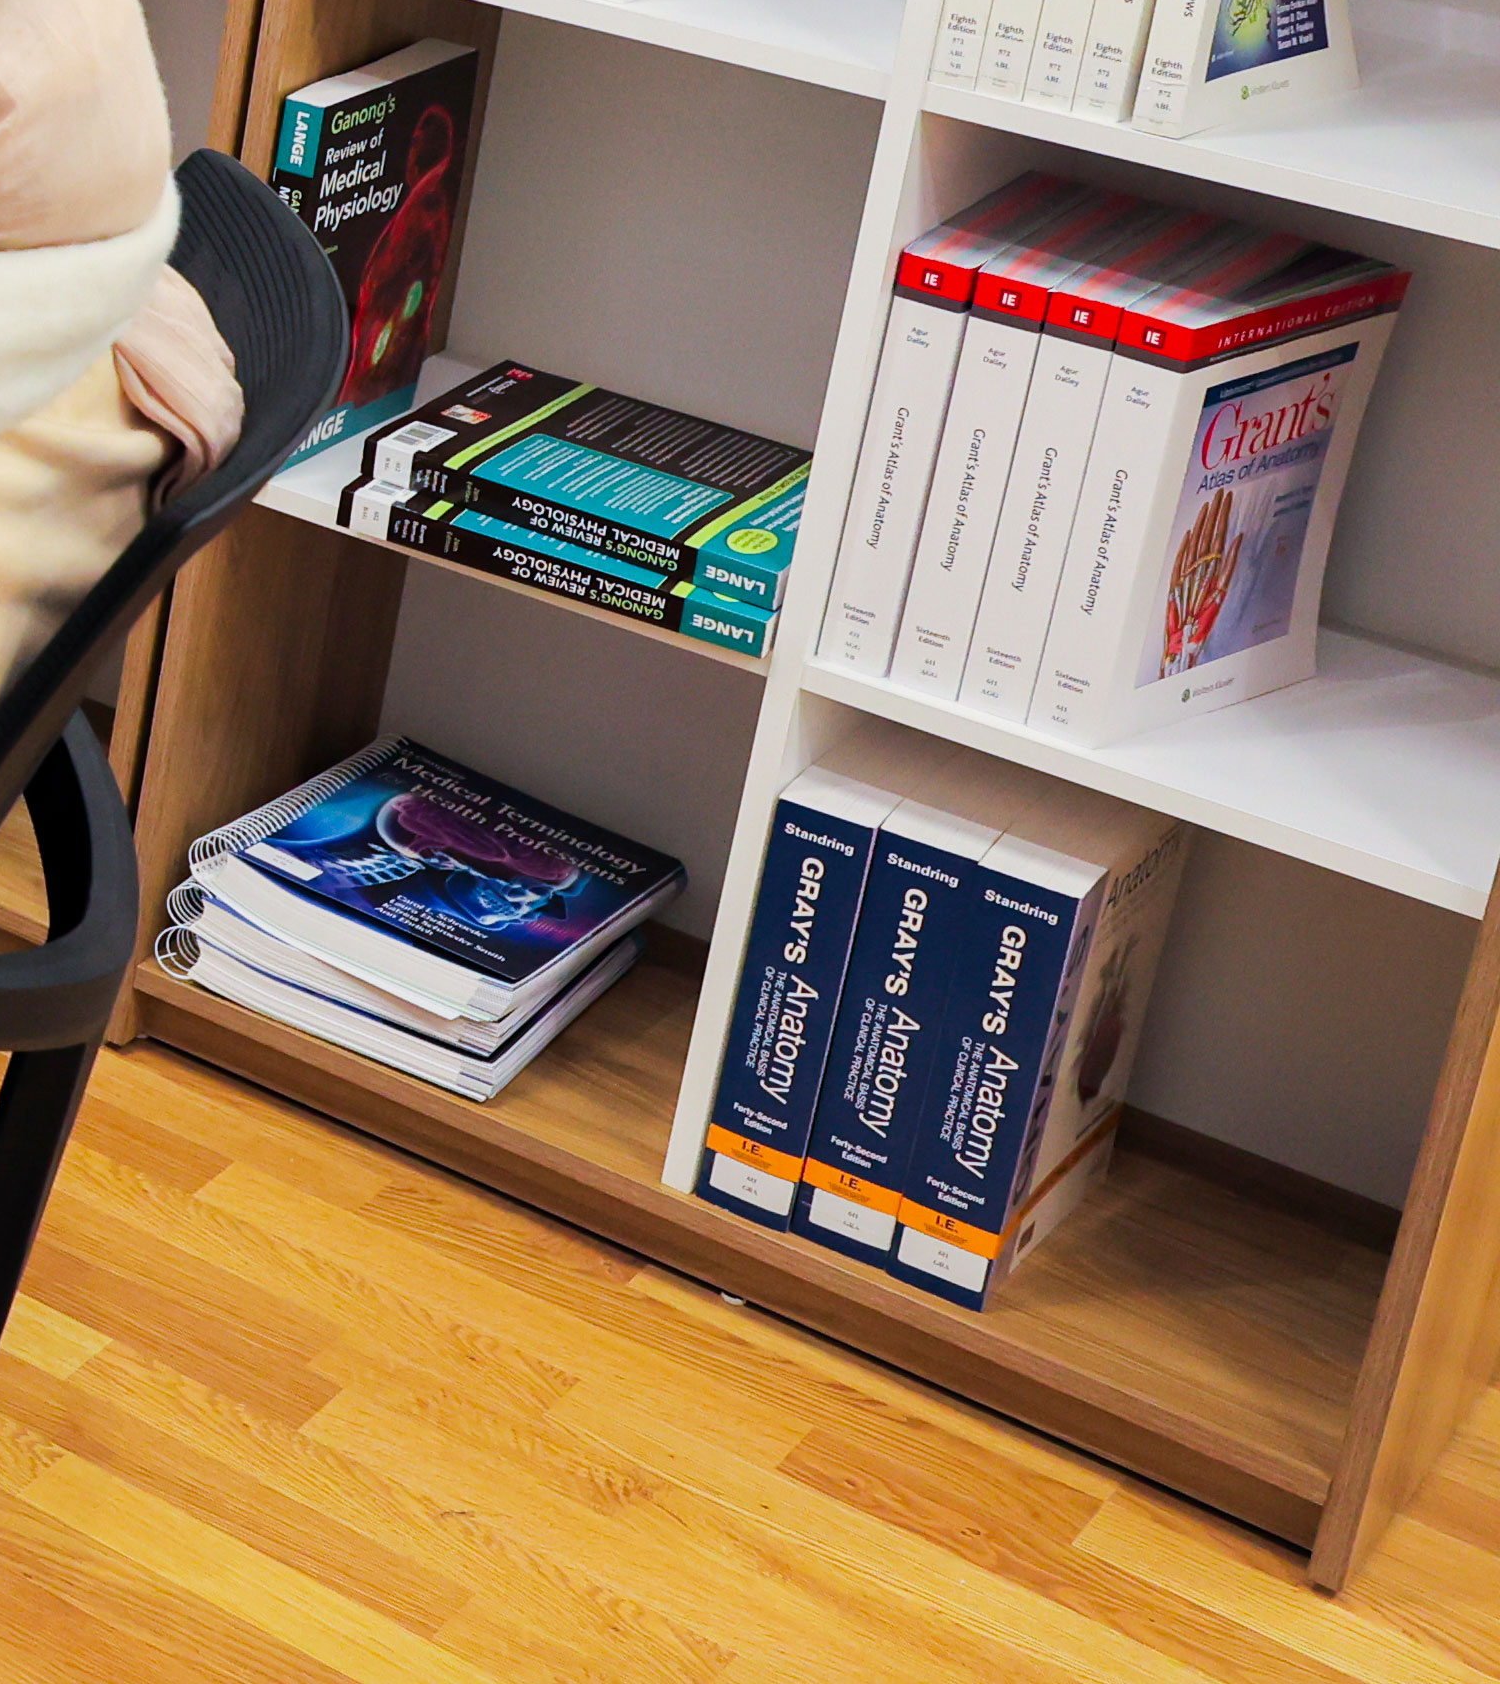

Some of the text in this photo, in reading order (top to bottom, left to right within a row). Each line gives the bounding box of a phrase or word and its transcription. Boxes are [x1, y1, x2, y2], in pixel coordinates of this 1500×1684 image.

[331, 93, 395, 134] Ganong's
[290, 111, 310, 168] LANGE
[325, 128, 384, 166] Review of
[320, 151, 386, 199] Medical
[314, 183, 403, 232] Physiology
[924, 272, 938, 286] IE
[1146, 330, 1160, 345] IE
[1218, 296, 1375, 348] INTERNATIONAL EDITION
[1202, 373, 1334, 470] Grant's
[866, 407, 909, 549] Grant's Atlas of Anatomy
[1197, 443, 1318, 494] Atlas of Anatomy
[511, 497, 680, 560] MEDICAL PHYSIOLOGY
[530, 517, 678, 571] GANONG'S REVIEW OF
[705, 565, 767, 595] LANGE
[392, 757, 647, 874] Medical Terminology
[409, 783, 627, 886] Health Professions
[784, 823, 855, 857] Standring
[984, 890, 1058, 926] Standring
[761, 857, 825, 1105] GRAY'S Anatomy
[858, 888, 928, 1138] GRAY'S Anatomy
[955, 925, 1027, 1179] GRAY'S Anatomy
[733, 1102, 788, 1130] Forty-Second
